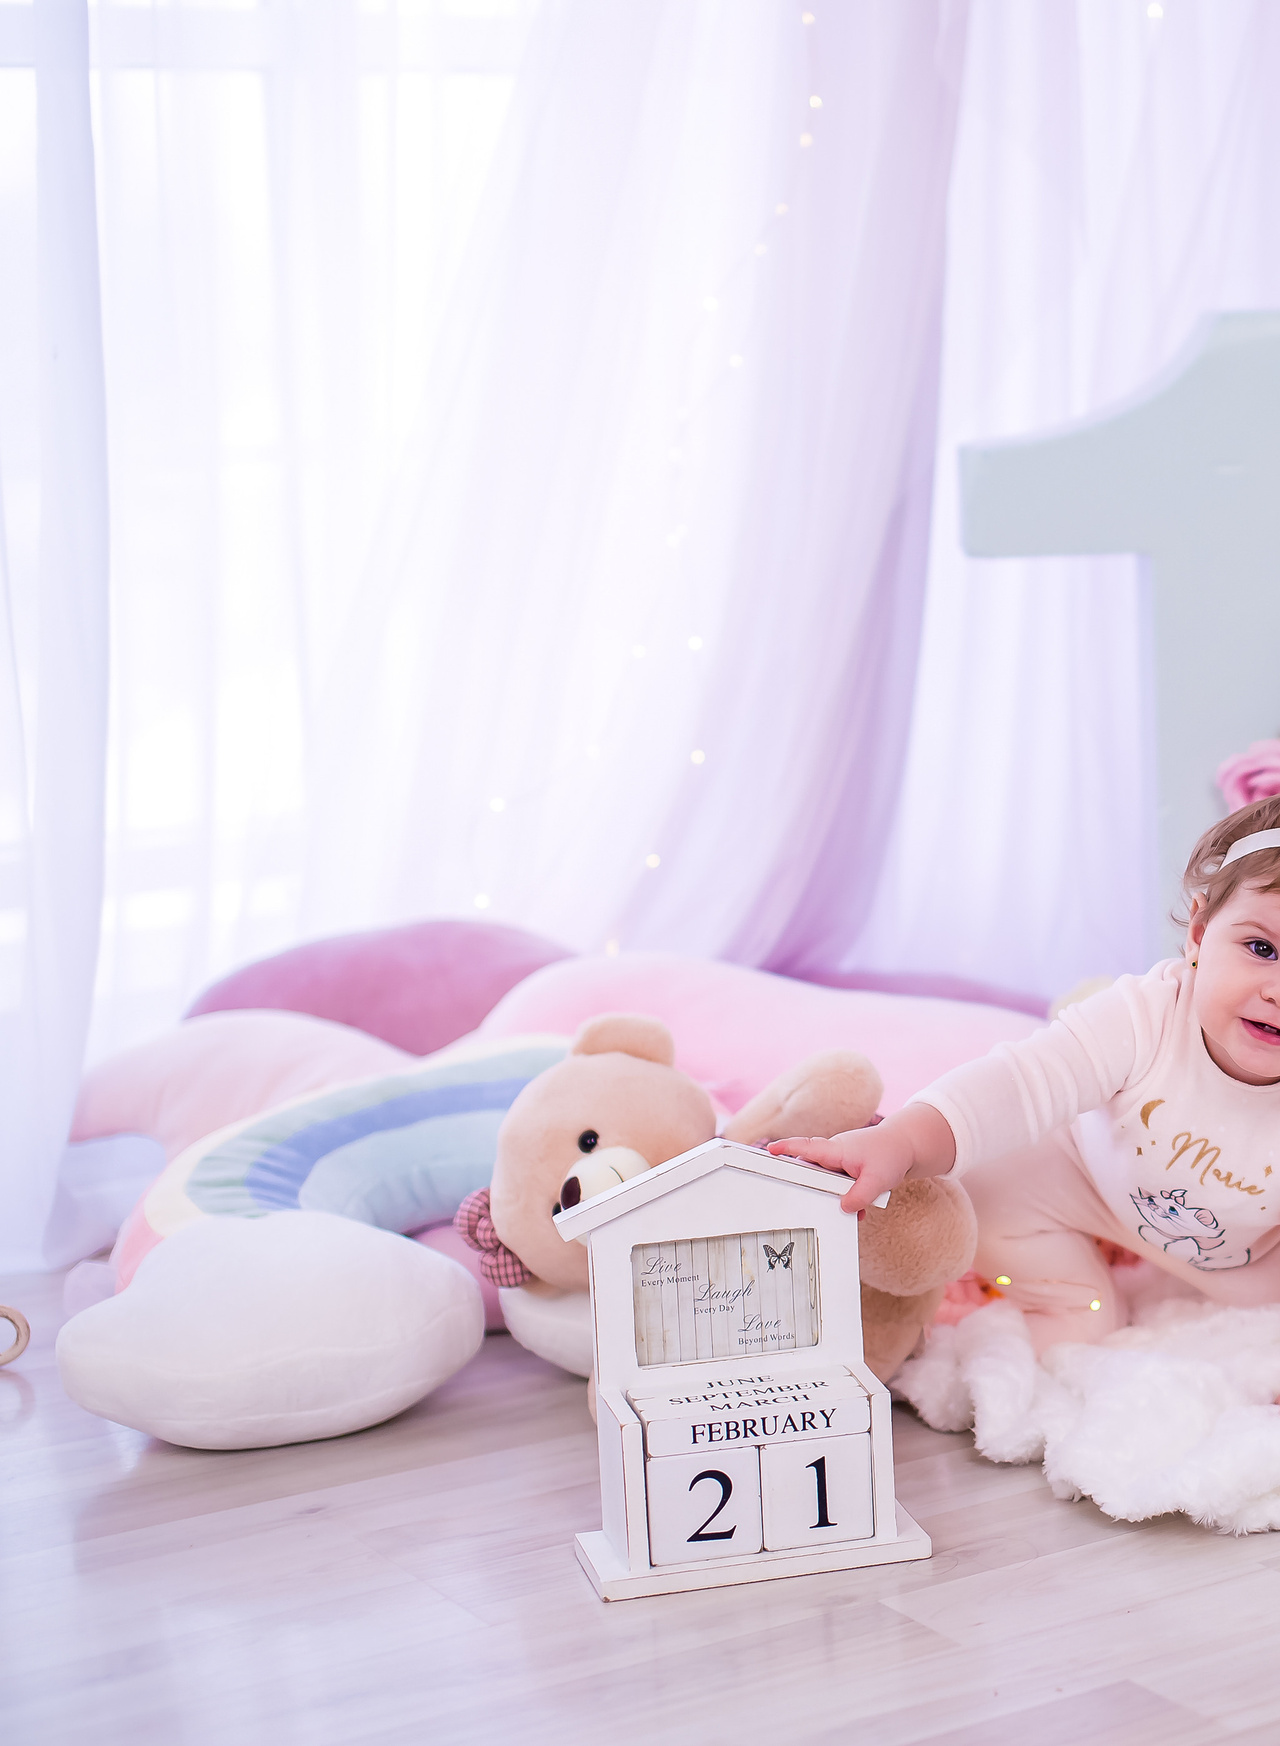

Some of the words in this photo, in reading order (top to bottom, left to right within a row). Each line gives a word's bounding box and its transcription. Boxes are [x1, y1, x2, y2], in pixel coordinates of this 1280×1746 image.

[1165, 1131, 1266, 1196] Marie
[640, 1256, 682, 1276] Live
[641, 1278, 665, 1287] Every
[666, 1274, 700, 1285] Moment
[693, 1279, 756, 1303] Laugh
[693, 1305, 717, 1315] Every
[719, 1304, 735, 1313] Day
[737, 1314, 782, 1333] Love
[738, 1335, 768, 1346] Beyond
[769, 1332, 795, 1342] Words
[706, 1375, 774, 1389] JUNE
[668, 1380, 830, 1405] SEPTEMBER
[709, 1394, 811, 1412] MARCH
[690, 1408, 837, 1445] FEBRUARY
